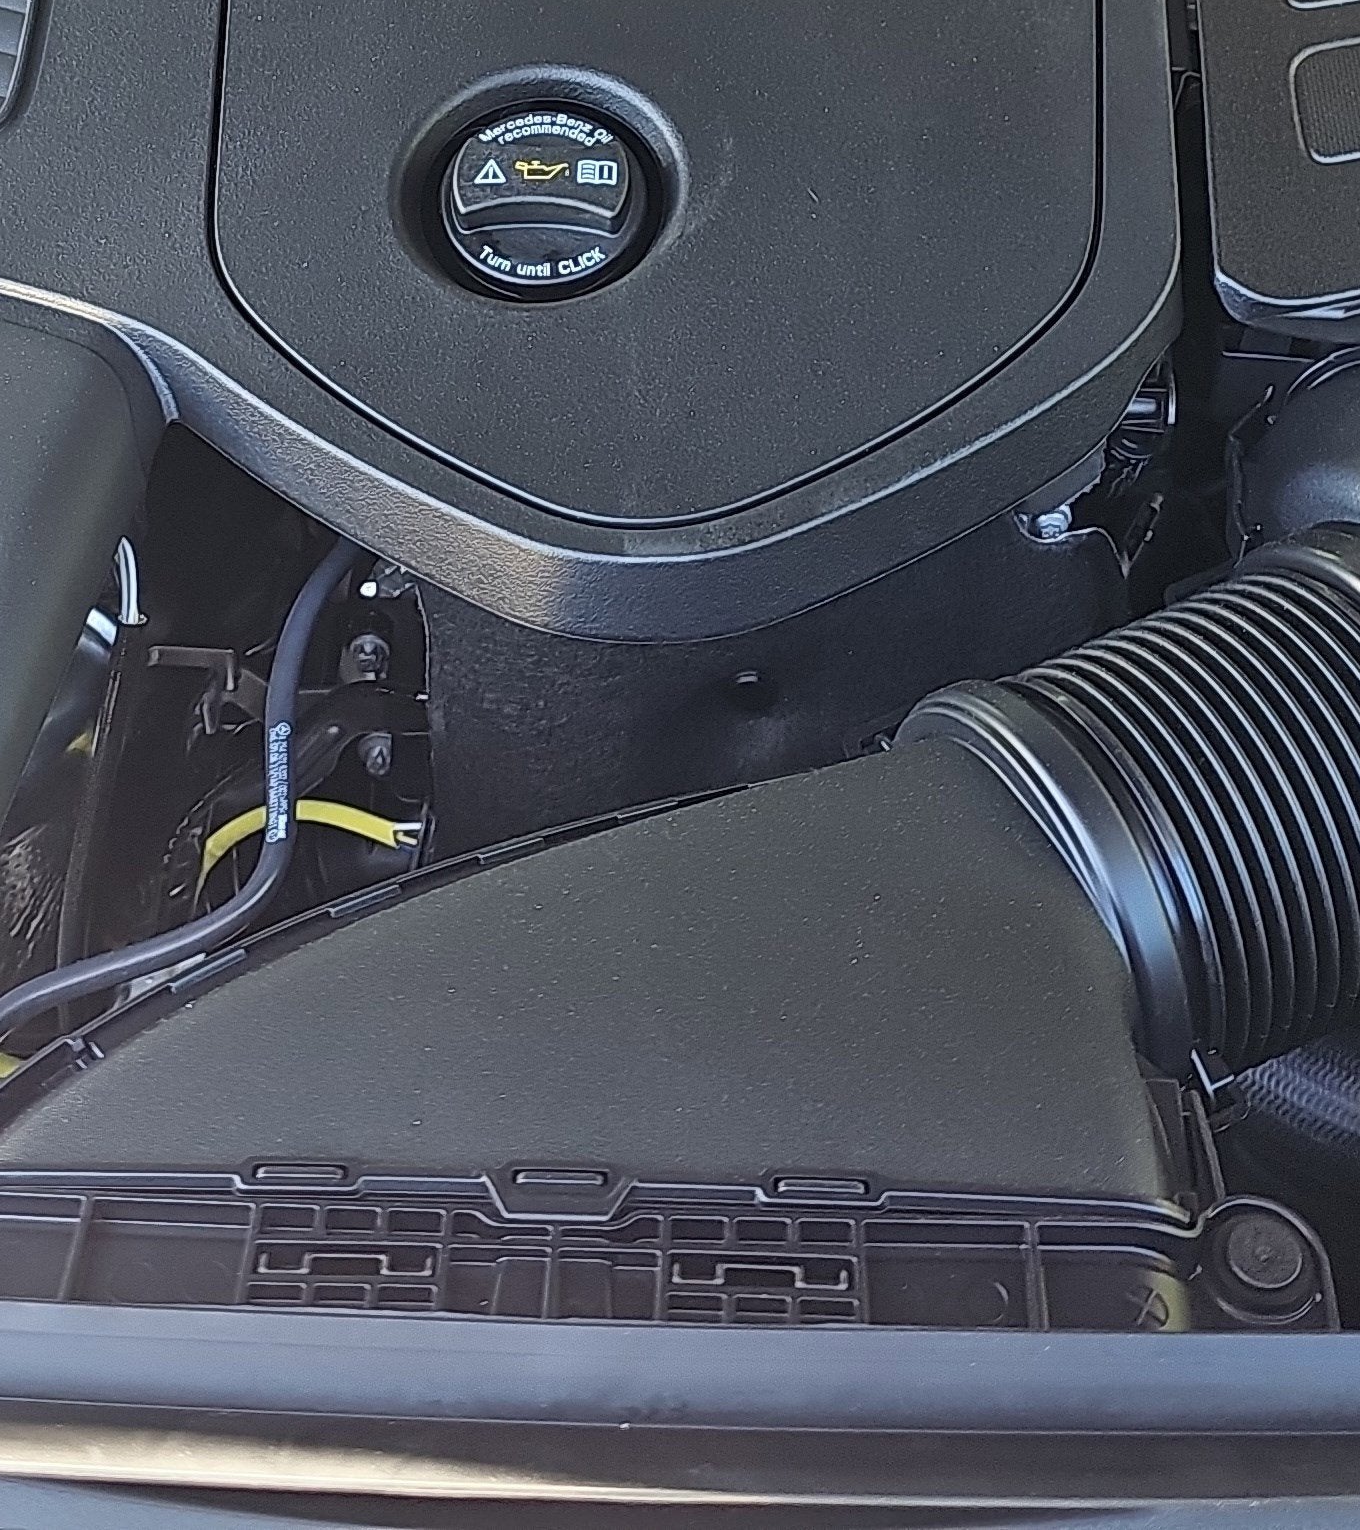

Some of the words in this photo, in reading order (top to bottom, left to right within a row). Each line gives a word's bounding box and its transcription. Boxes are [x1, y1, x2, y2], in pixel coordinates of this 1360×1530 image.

[478, 114, 594, 142] Mercedes-Benz
[593, 128, 614, 145] Oil
[497, 124, 597, 147] recommended
[479, 244, 512, 272] Turn
[516, 262, 551, 277] until
[557, 246, 606, 275] CLICK
